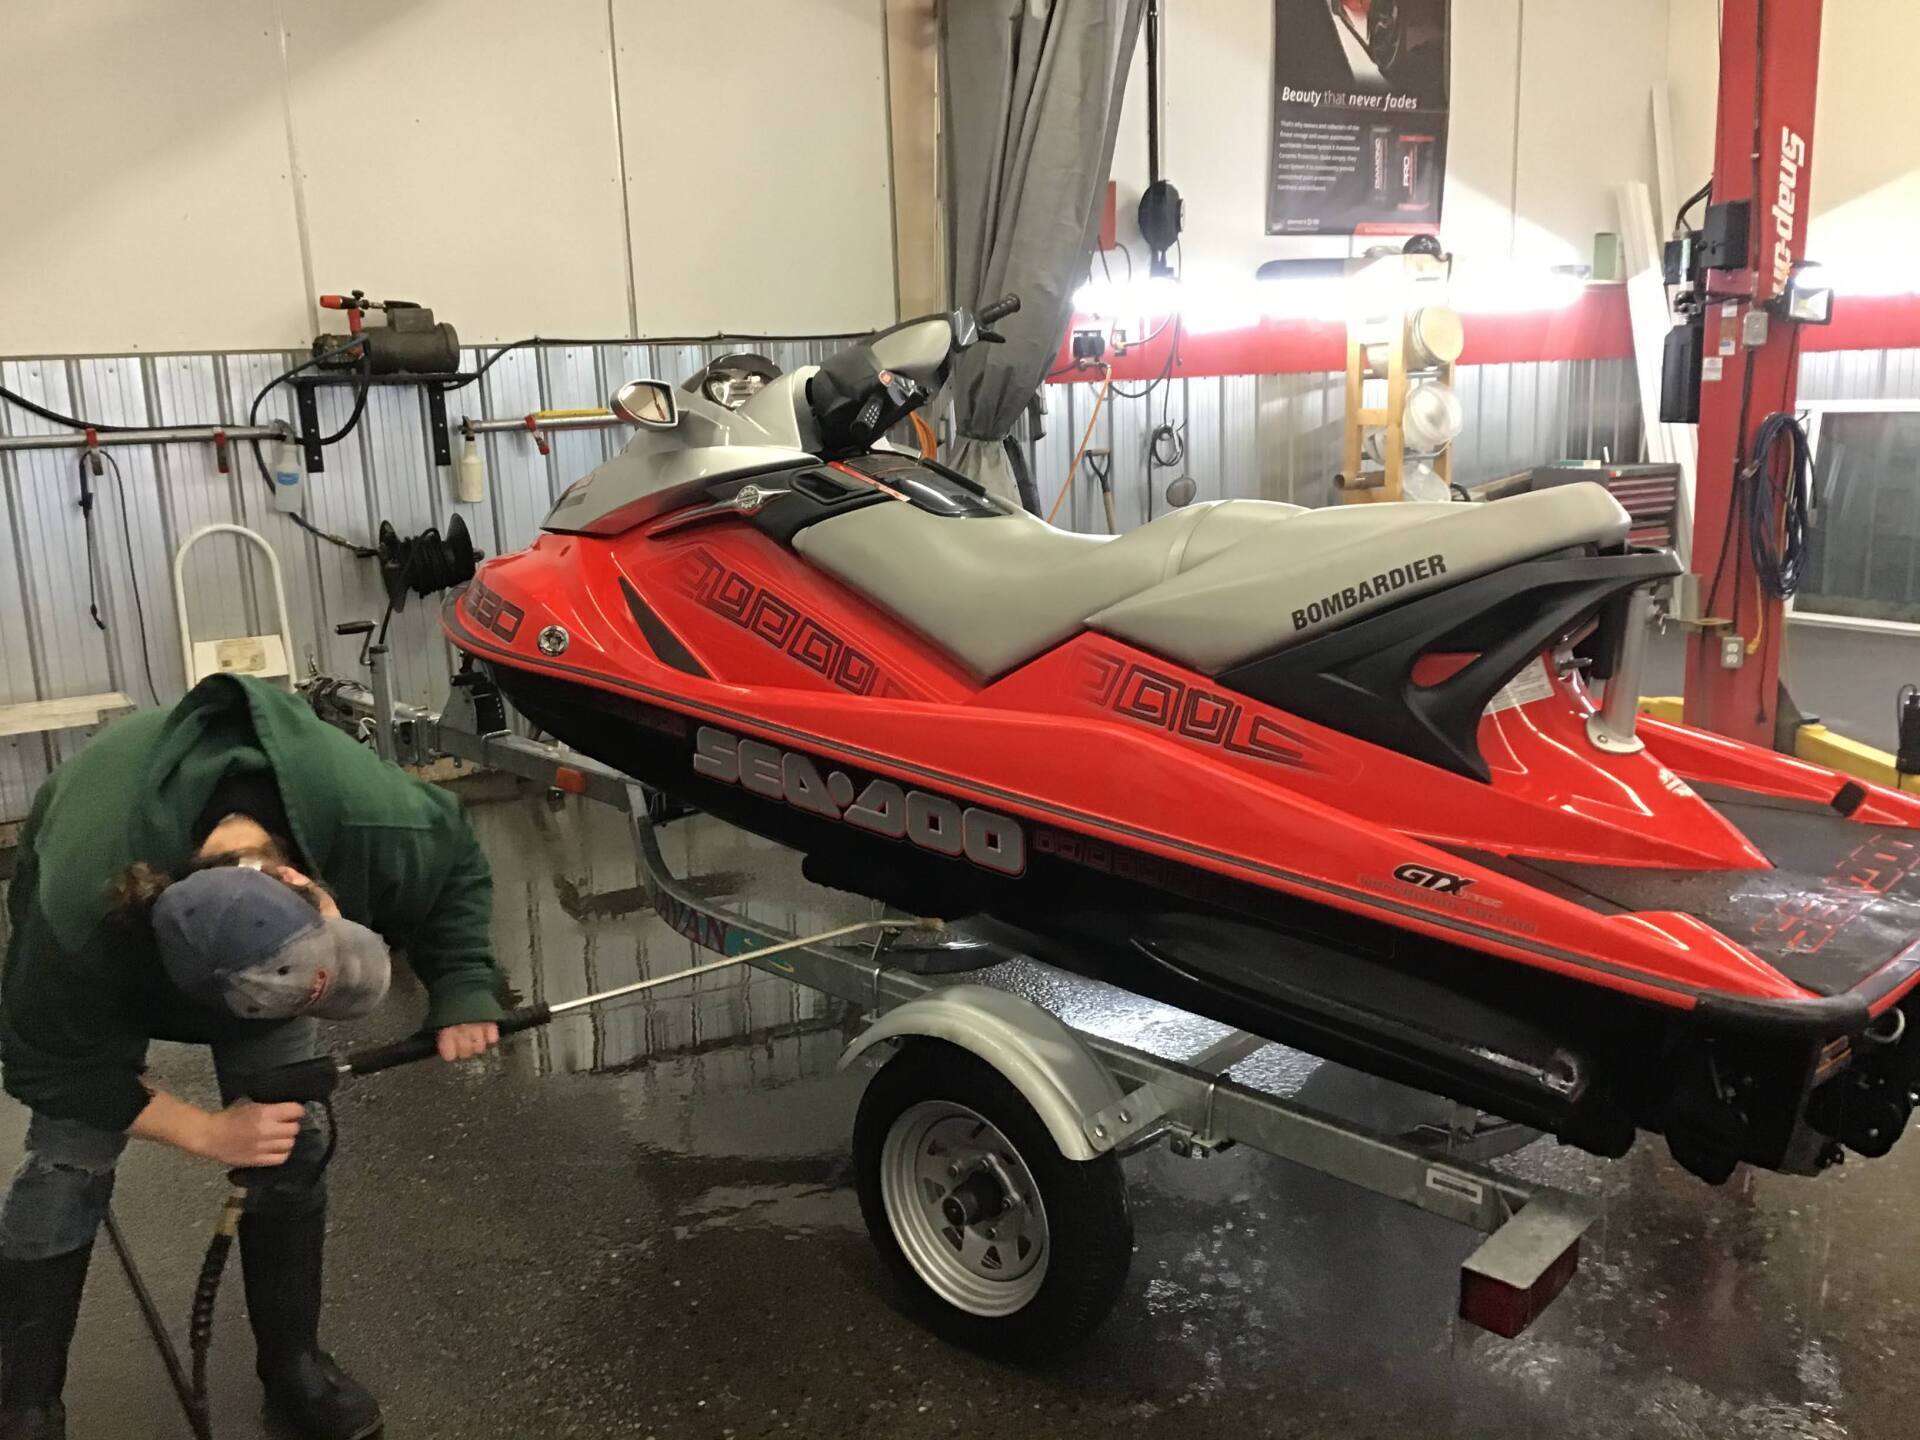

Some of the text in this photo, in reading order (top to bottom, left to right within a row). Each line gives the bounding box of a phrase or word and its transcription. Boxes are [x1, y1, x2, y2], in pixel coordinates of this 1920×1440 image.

[1282, 86, 1418, 112] Beauty that never fades
[1291, 554, 1447, 631] BOMBARDIER
[1392, 862, 1477, 895] GTX
